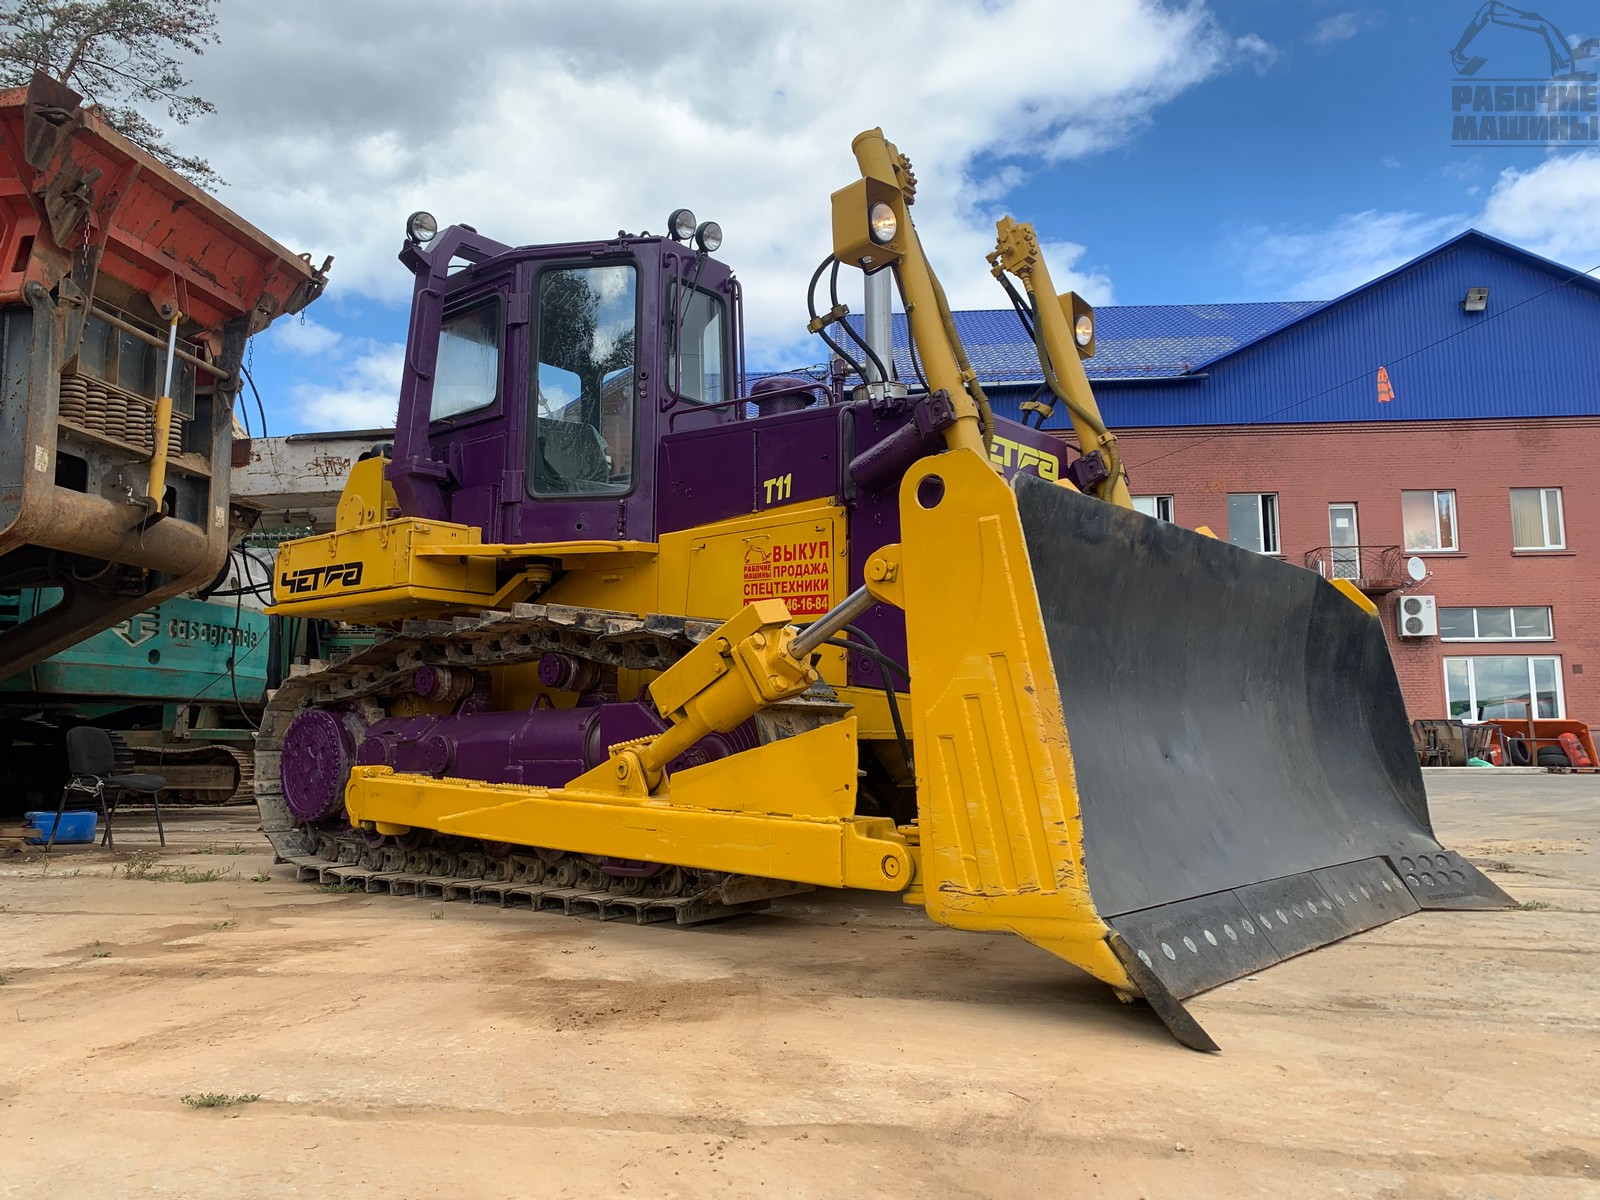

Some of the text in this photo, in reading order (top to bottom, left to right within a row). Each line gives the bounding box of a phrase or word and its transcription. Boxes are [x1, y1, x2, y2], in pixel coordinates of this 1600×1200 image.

[773, 541, 829, 563] ВЫКУП
[744, 564, 771, 573] РАБОЧИЕ
[744, 572, 771, 580] МАШИНЫ
[773, 562, 828, 578] ПРОДАЖА
[744, 578, 829, 596] СПЕЦТЕХНИКИ
[168, 618, 257, 648] casagrande
